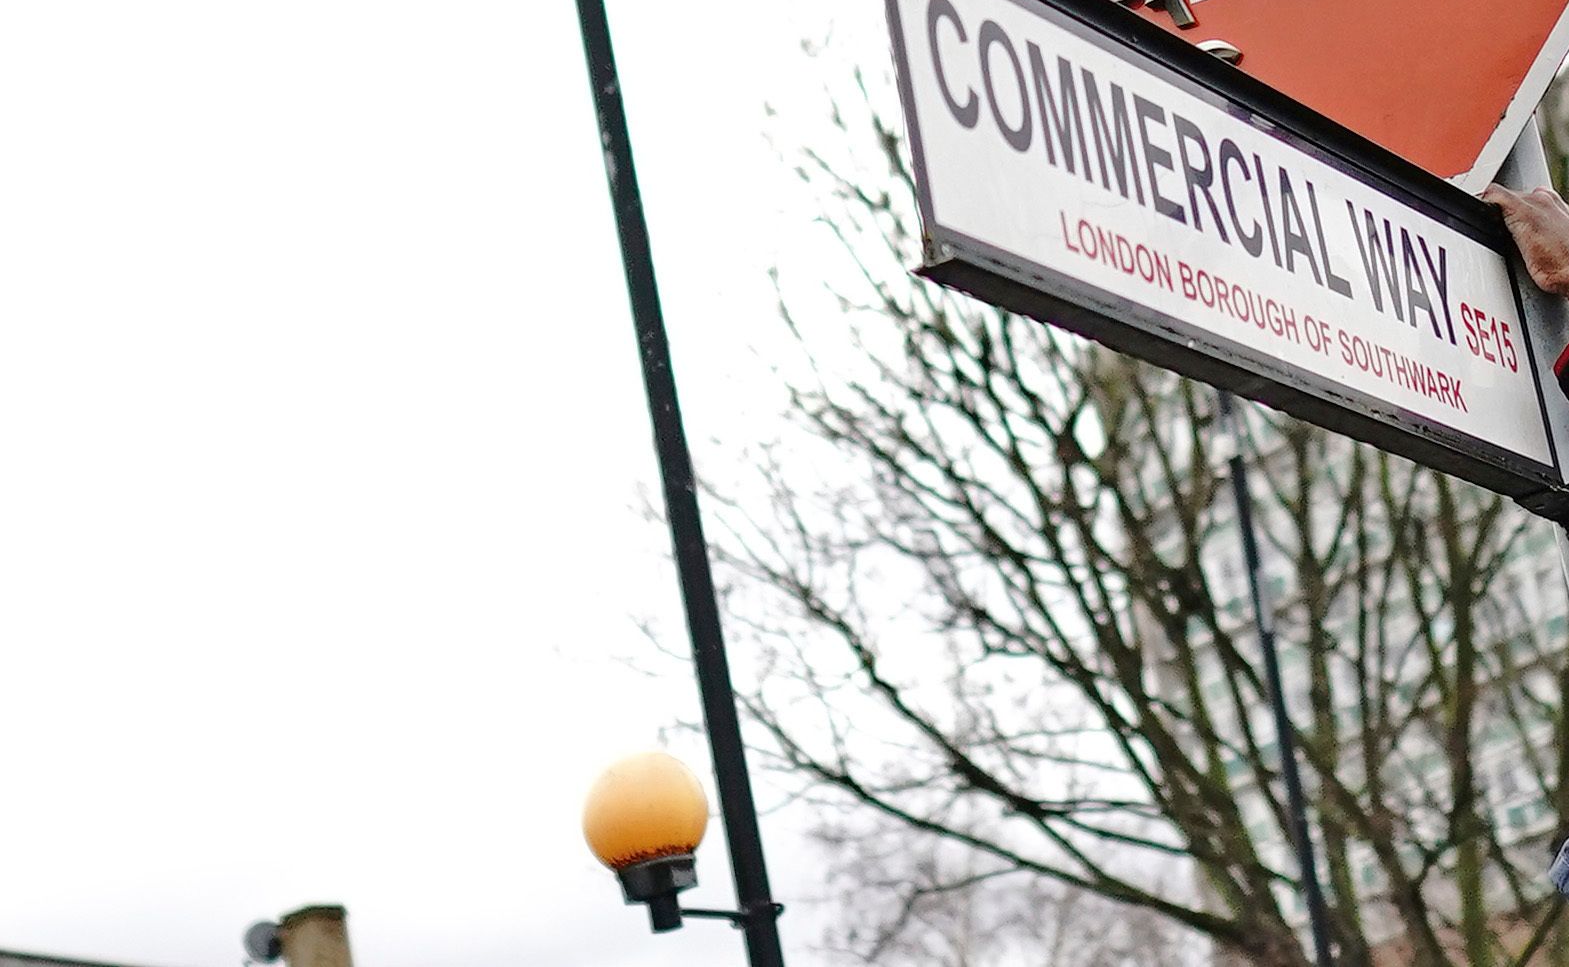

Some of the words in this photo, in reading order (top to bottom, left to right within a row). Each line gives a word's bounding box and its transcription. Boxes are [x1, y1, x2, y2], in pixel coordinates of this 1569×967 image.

[1060, 210, 1174, 293] LONDON
[1178, 261, 1301, 344] BOROUGH
[1304, 315, 1332, 356] OF
[1338, 329, 1468, 413] SOUTHWARK
[1345, 198, 1457, 346] WAY
[1460, 301, 1518, 374] SE15
